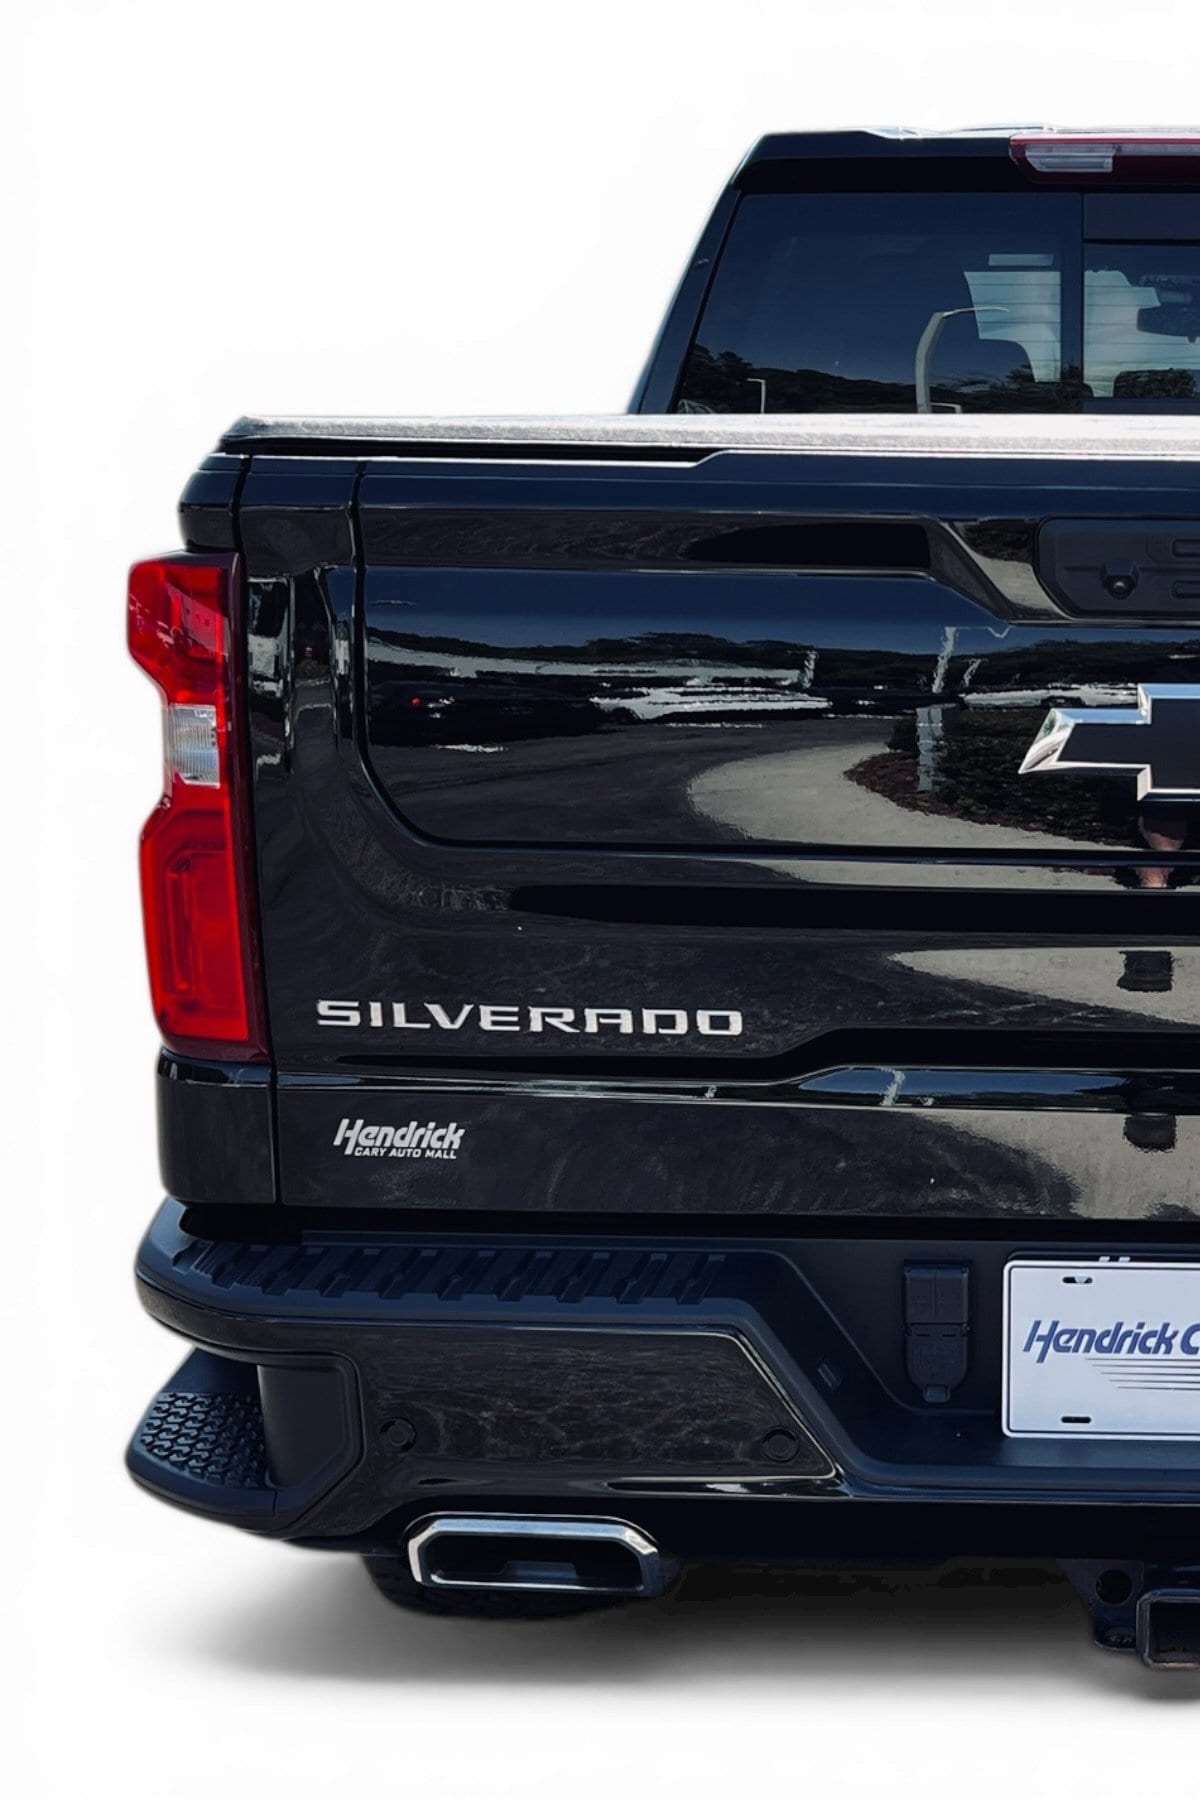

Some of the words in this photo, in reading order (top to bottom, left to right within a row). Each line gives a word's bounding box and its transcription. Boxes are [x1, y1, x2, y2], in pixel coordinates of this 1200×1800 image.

[316, 1000, 743, 1035] SILVERADO
[333, 1118, 465, 1155] Hendrick
[354, 1147, 387, 1157] CARY
[388, 1148, 422, 1158] AUTO
[424, 1150, 457, 1159] MALL
